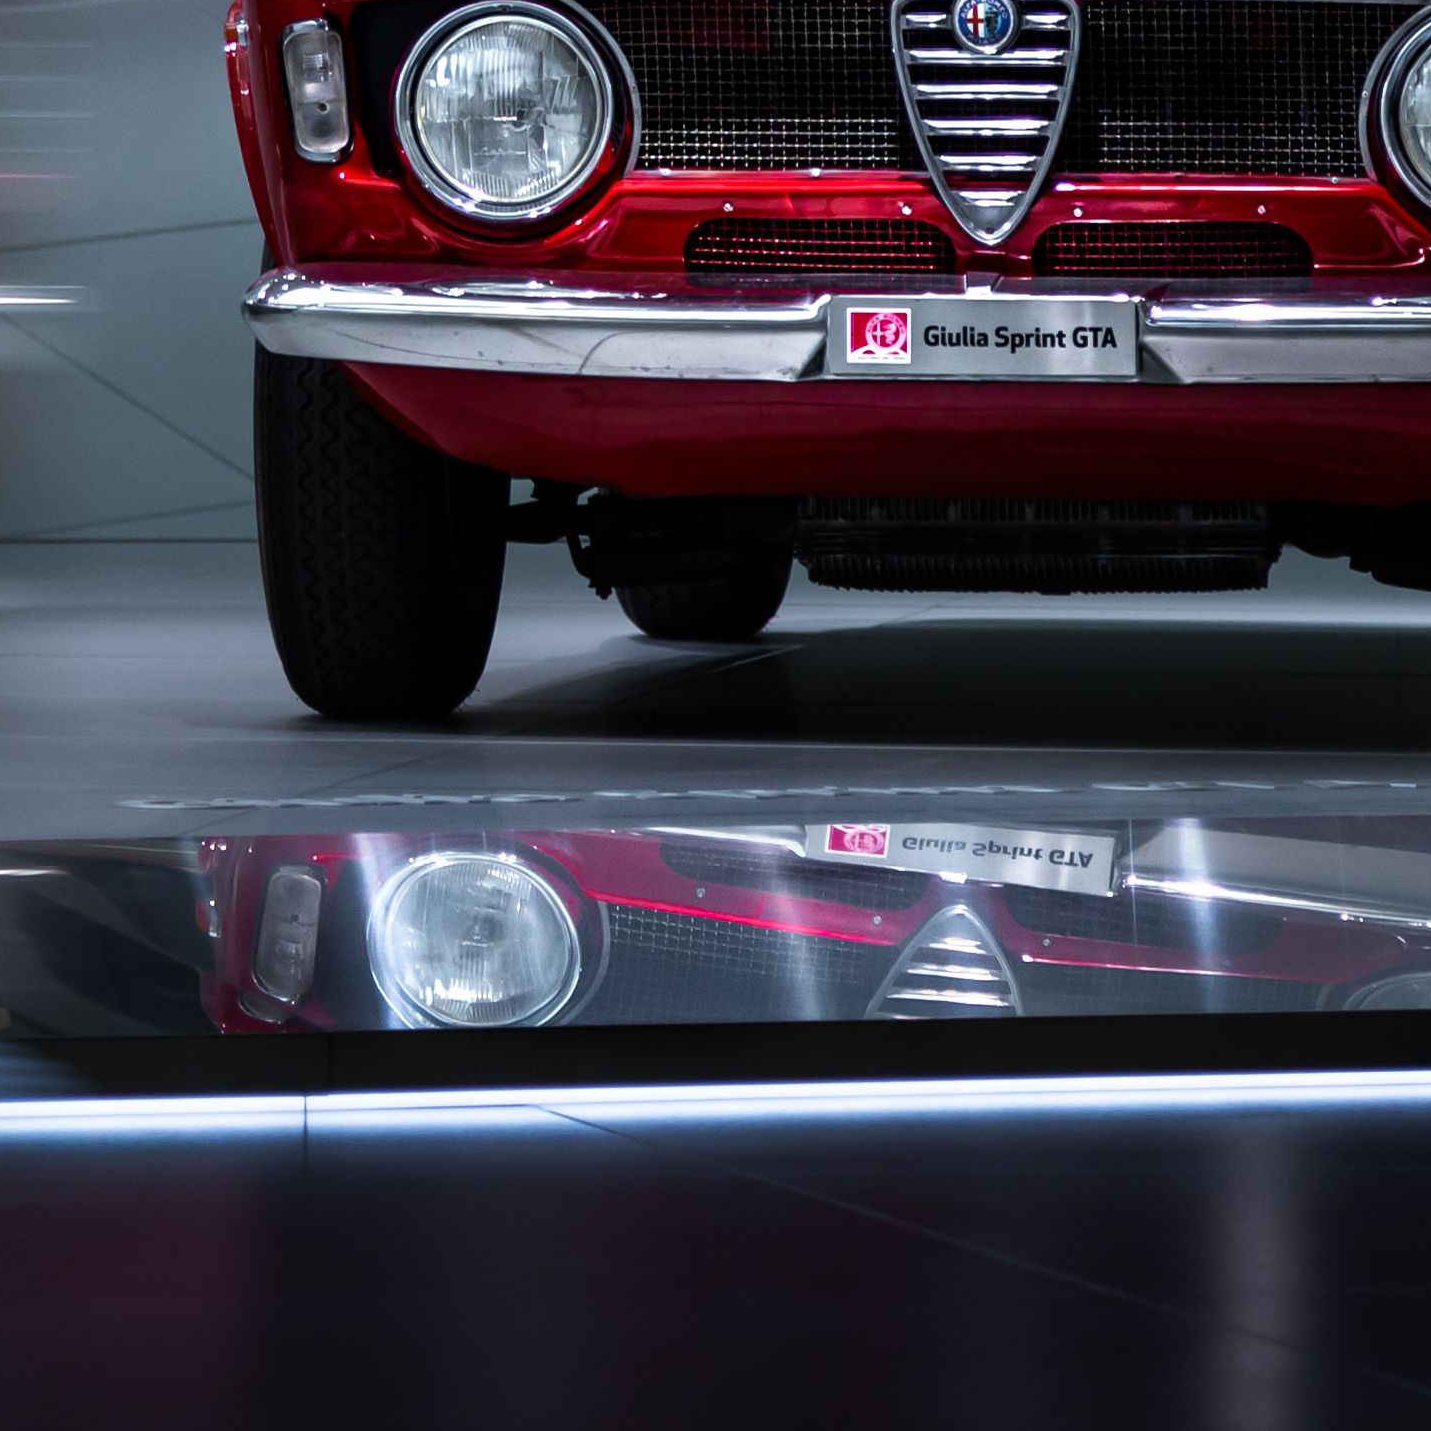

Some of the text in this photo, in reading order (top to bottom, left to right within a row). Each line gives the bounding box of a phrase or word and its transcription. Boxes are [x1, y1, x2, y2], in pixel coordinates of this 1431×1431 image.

[924, 325, 1118, 353] Giulia Sprint GTA
